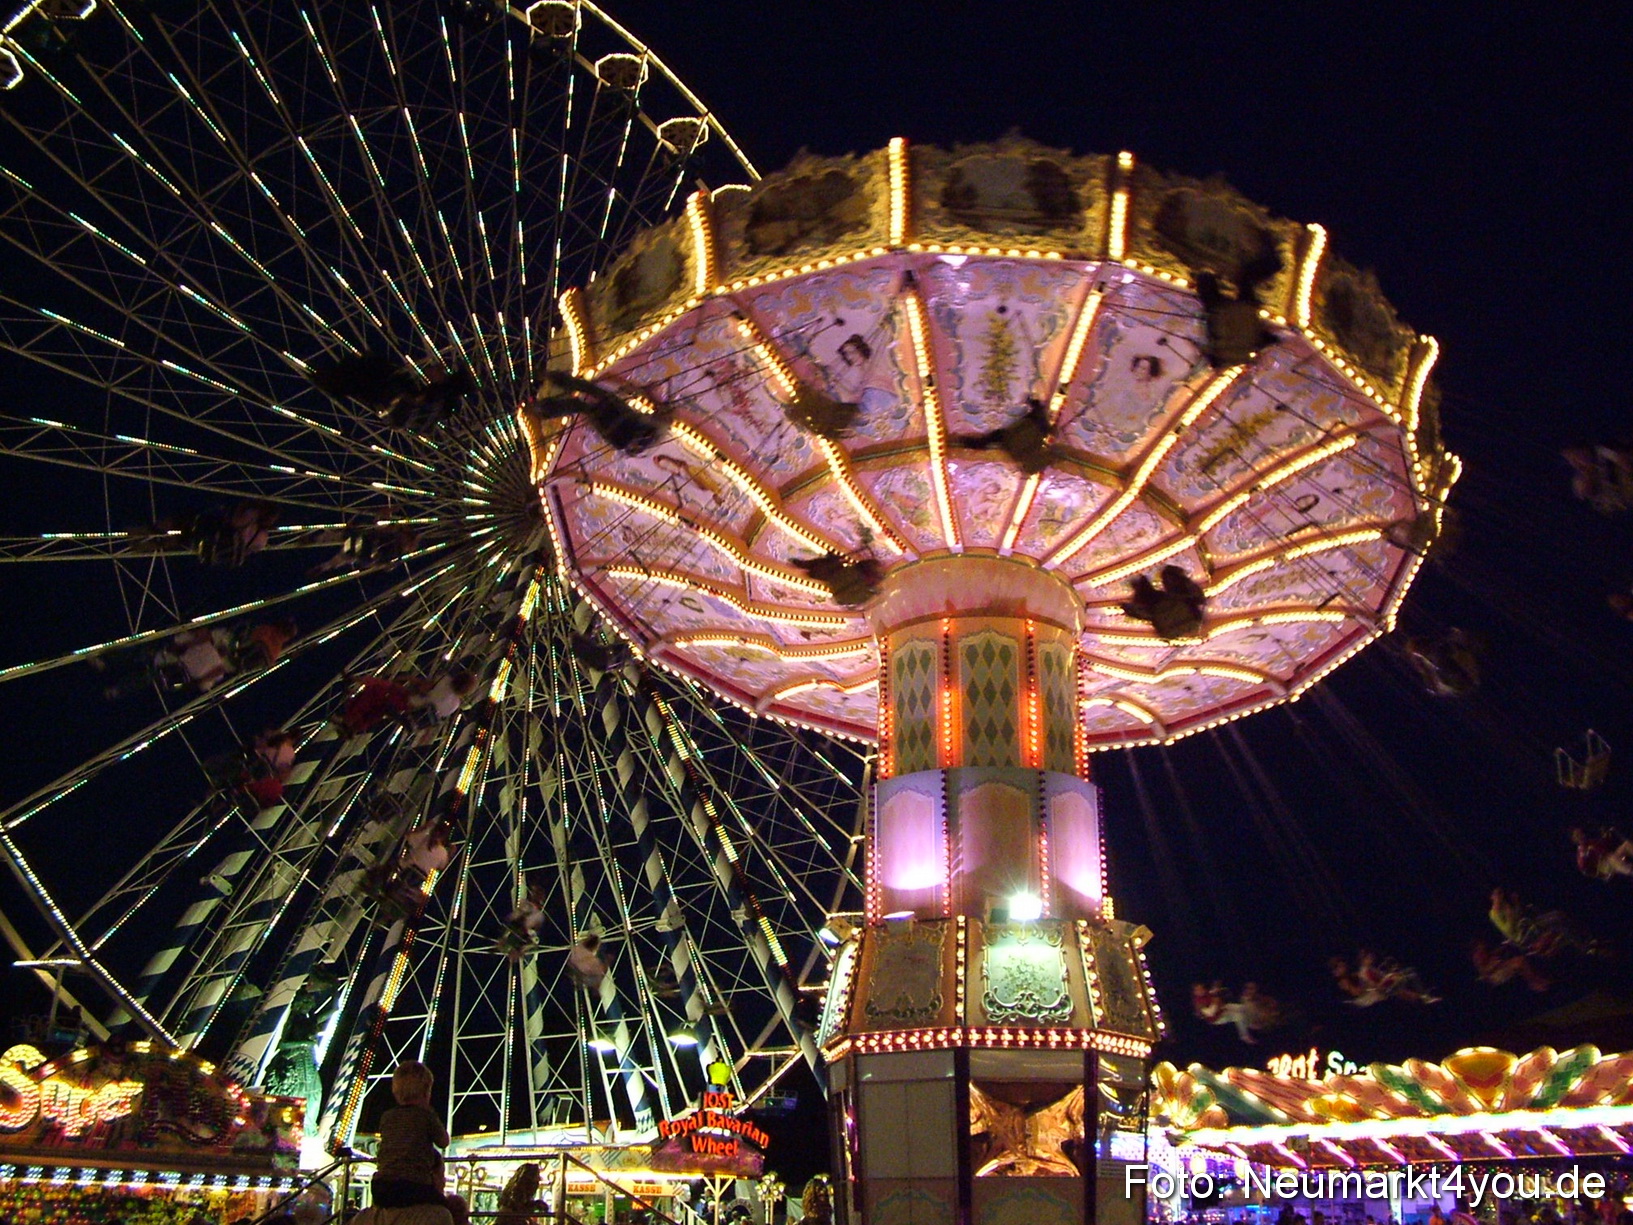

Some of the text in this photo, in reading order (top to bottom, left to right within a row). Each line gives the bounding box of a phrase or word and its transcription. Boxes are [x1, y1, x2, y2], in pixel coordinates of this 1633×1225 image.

[658, 1110, 769, 1149] Royal Bavarian
[692, 1135, 739, 1157] Wheel
[568, 1184, 596, 1192] KASSE
[633, 1185, 662, 1194] KASSE
